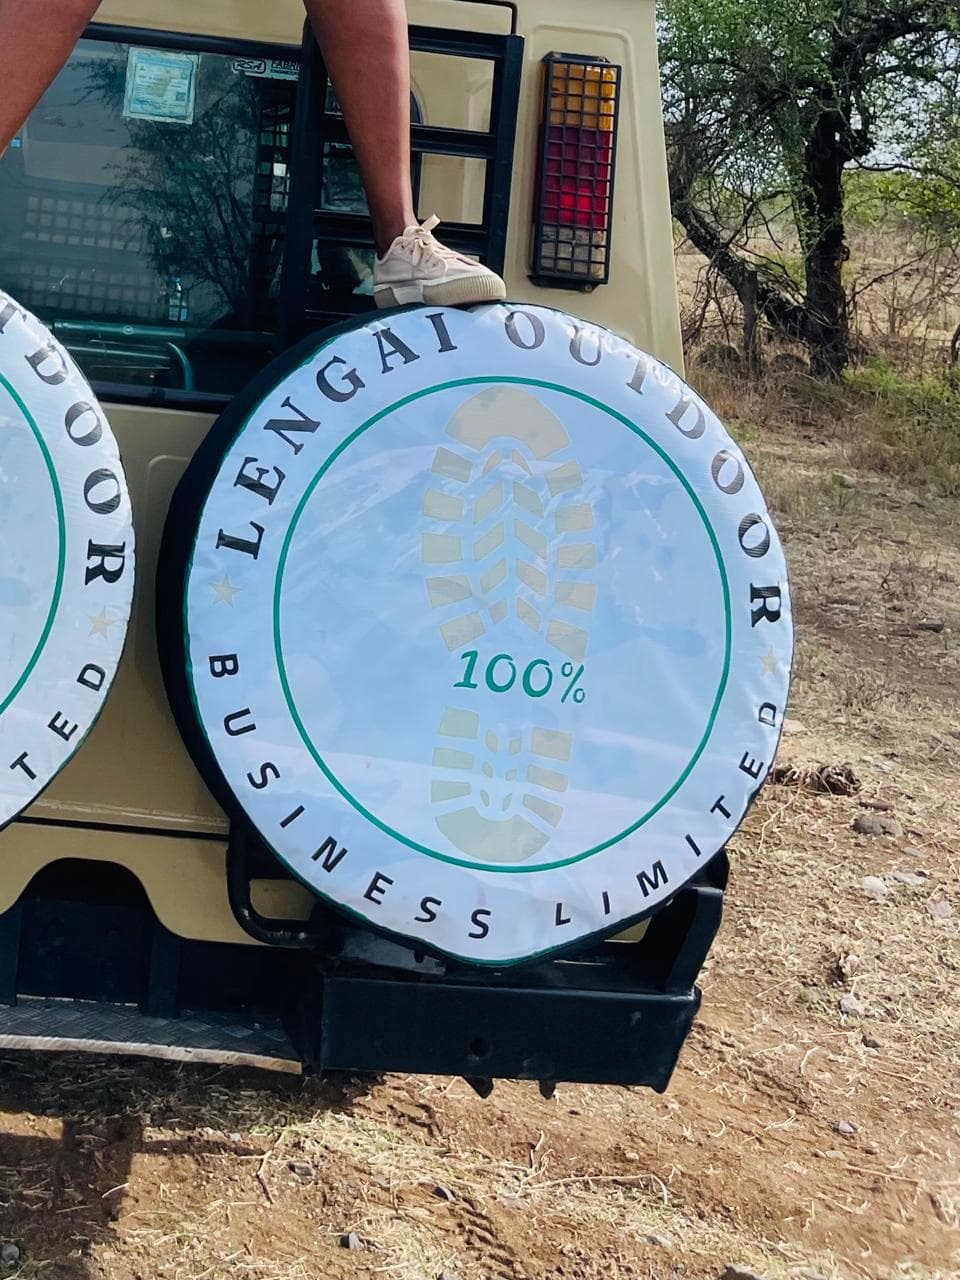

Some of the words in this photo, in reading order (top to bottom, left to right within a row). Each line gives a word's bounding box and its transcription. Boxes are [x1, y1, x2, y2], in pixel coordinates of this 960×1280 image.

[236, 60, 262, 71] RSA
[216, 311, 458, 560] LENGAI
[504, 309, 782, 629] OUTDOOR
[452, 650, 586, 704] 100%
[208, 654, 491, 941] BUSINESS
[554, 702, 778, 928] LIMITED
